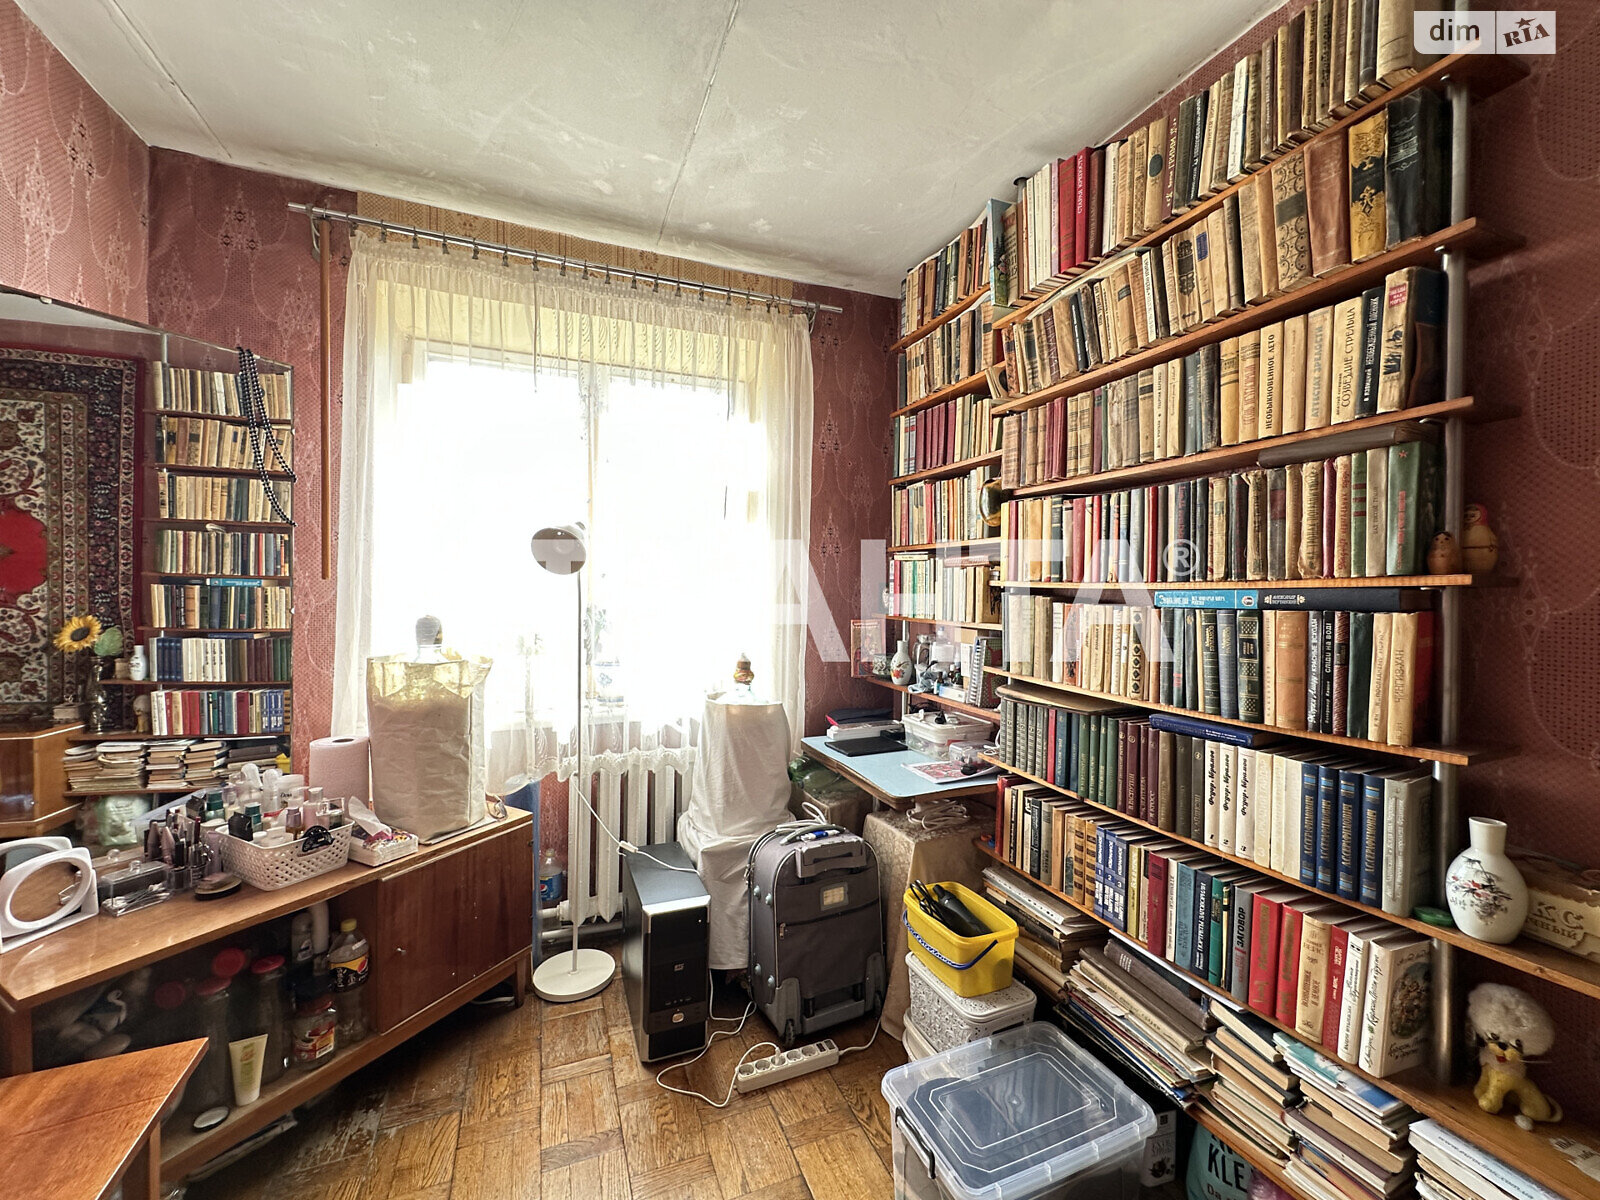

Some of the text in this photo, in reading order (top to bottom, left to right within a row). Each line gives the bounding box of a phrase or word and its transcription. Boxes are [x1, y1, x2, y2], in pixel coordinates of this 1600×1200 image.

[1369, 296, 1380, 321] ПЛЕННИК
[1341, 307, 1356, 408] СОЗВЕЗДИЕ СТРЕЛЬЦА
[1366, 322, 1378, 366] НЕПОБЕЖДЕННЫЙ
[1265, 355, 1275, 429] НЕОБЫКНОВЕННОЕ
[1311, 325, 1323, 418] АТТЕСТАТ ЗРЕЛОСТИ
[1237, 906, 1245, 948] ЗАГОВОР
[1208, 1143, 1255, 1193] KLE
